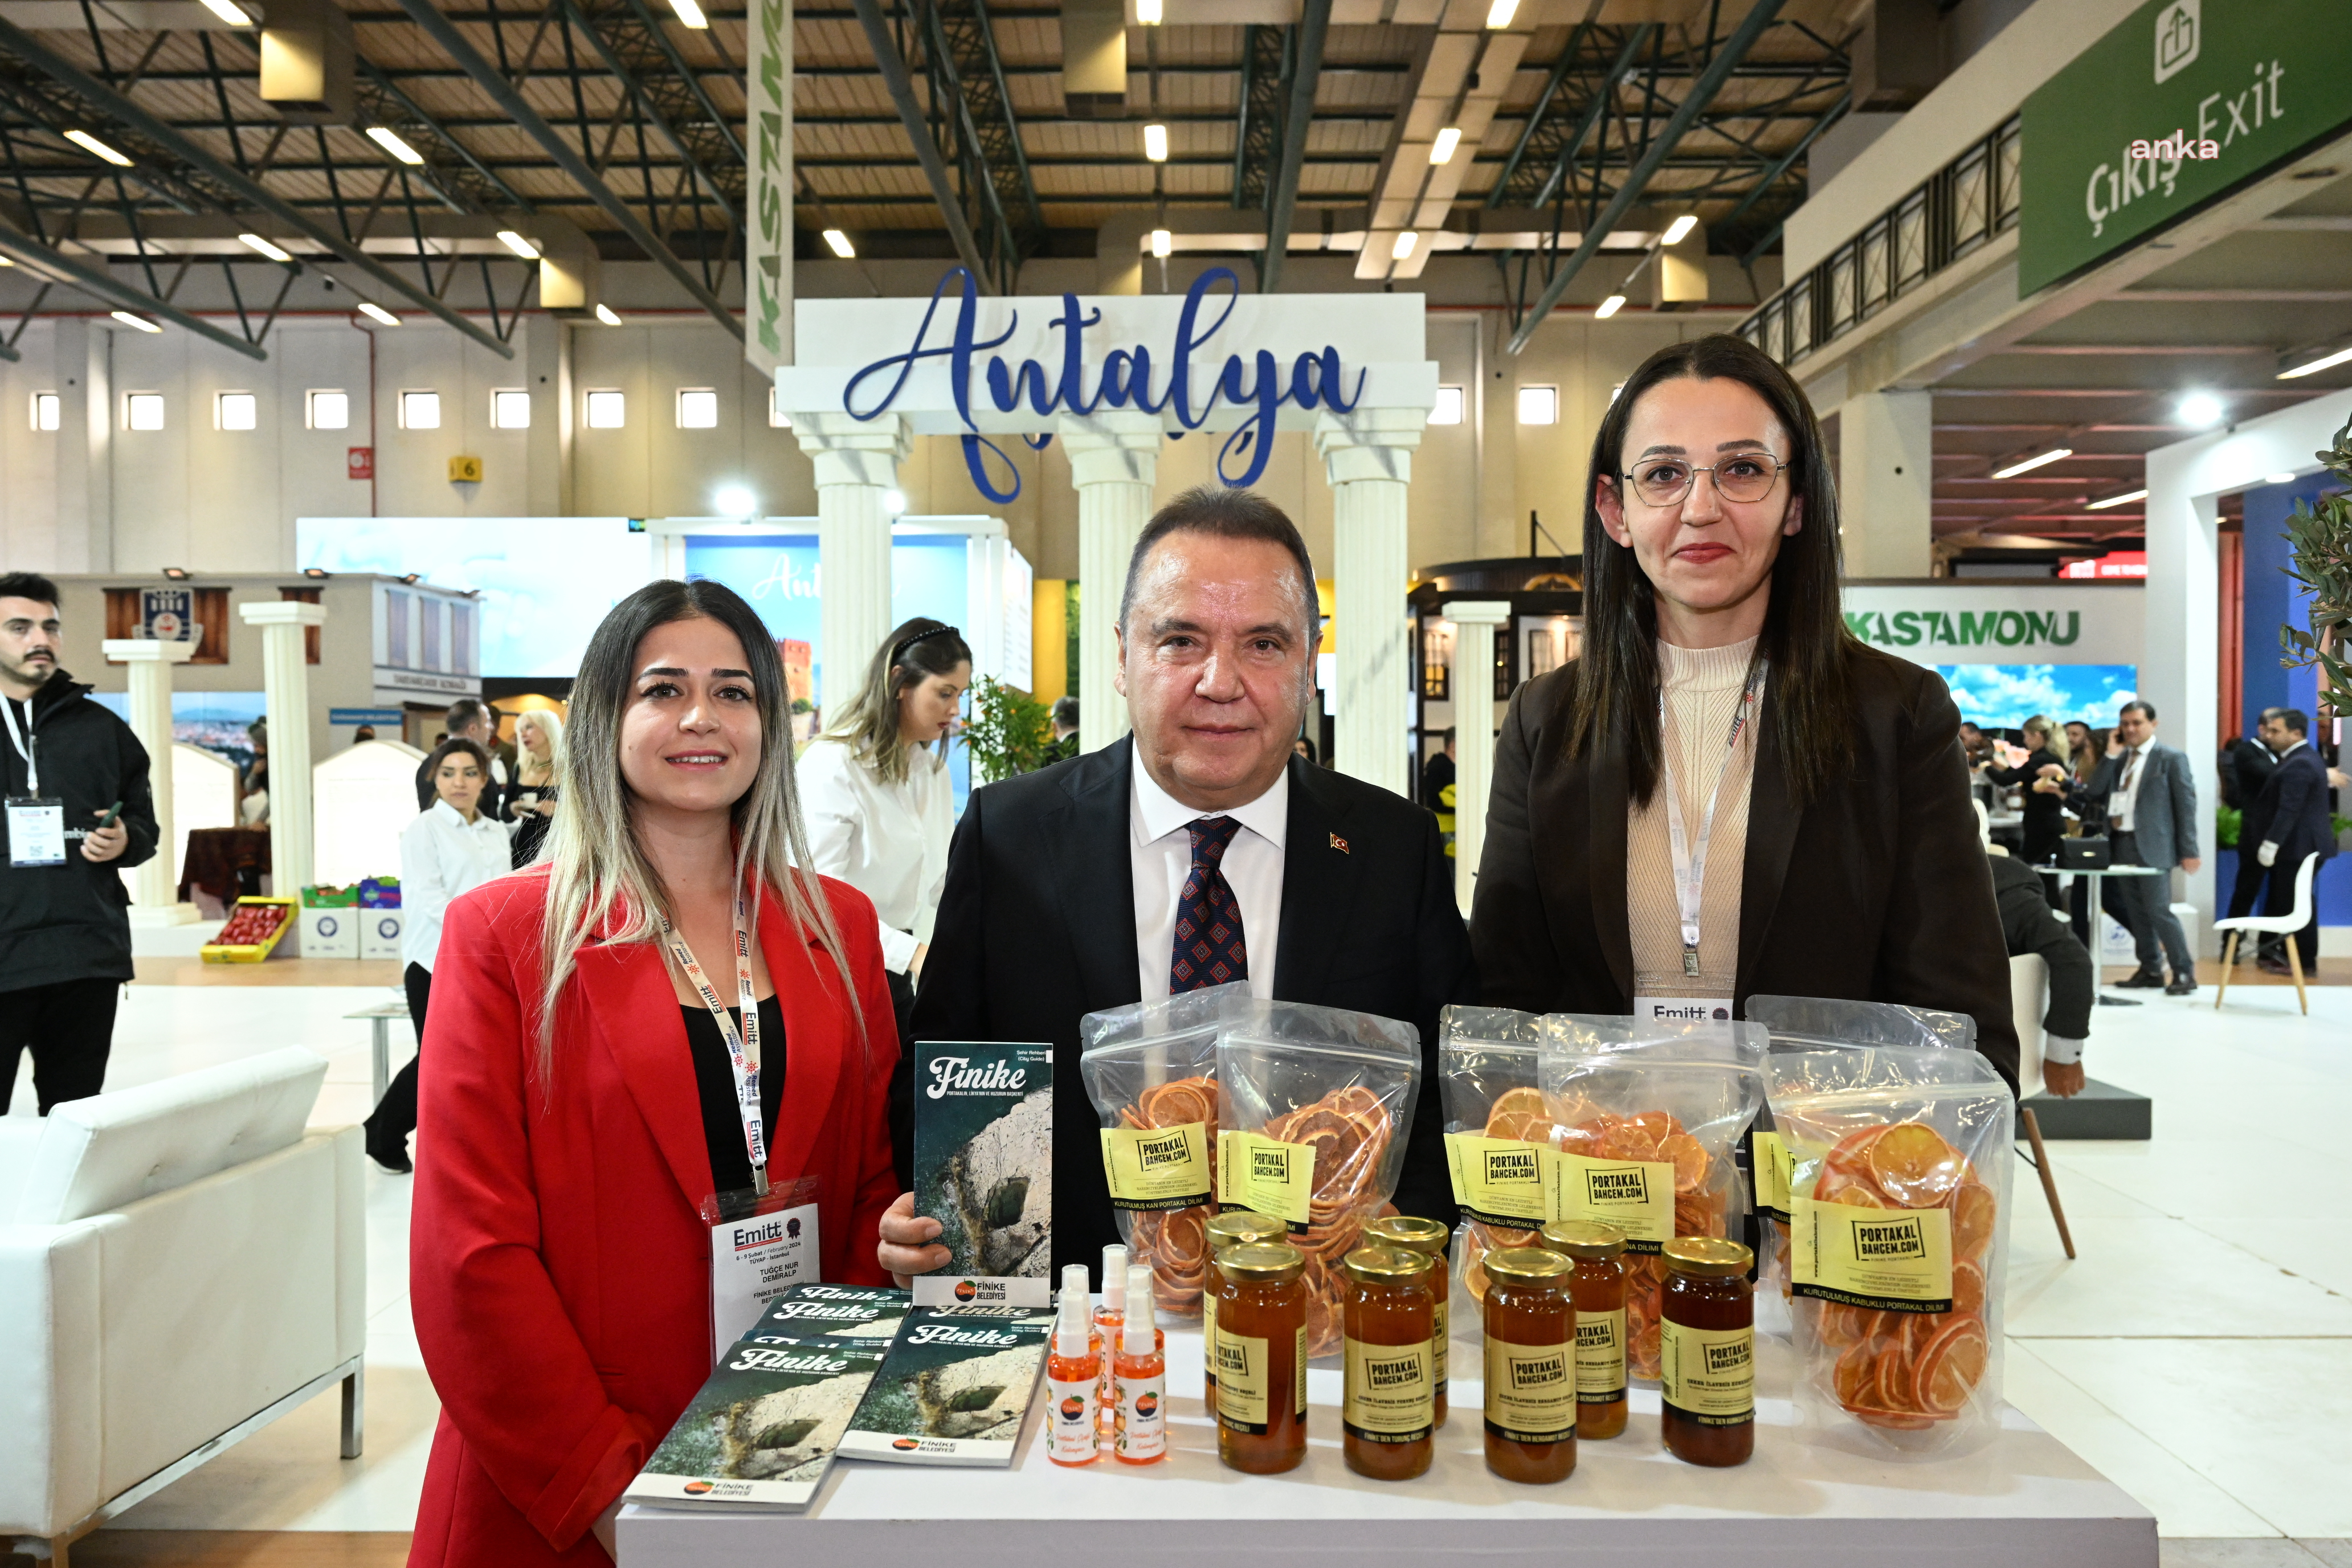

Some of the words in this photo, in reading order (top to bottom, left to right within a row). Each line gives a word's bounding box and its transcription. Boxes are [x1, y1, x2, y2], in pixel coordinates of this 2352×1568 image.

[2086, 131, 2184, 238] Çıkış
[2198, 58, 2285, 162] Exit
[843, 266, 1366, 504] Antalya
[1844, 610, 2080, 646] KASTAMONU
[738, 930, 749, 957] Emitt
[675, 949, 688, 964] Remed
[679, 942, 693, 962] Assistance
[700, 986, 723, 1014] Emitt
[746, 1012, 757, 1045] Emitt
[726, 1033, 736, 1053] Remed
[729, 1026, 741, 1052] Assistance
[926, 1056, 1026, 1099] Finike
[750, 1120, 762, 1158] Emitt
[1143, 1137, 1184, 1155] PORTAKAL
[1145, 1149, 1186, 1165] BAHCEM.COM
[1255, 1153, 1284, 1166] PORTAKAL
[1490, 1155, 1534, 1168] PORTAKAL
[1255, 1166, 1284, 1177] BAHCEM.COM
[1491, 1168, 1534, 1179] BAHCEM.COM
[1592, 1174, 1641, 1187] PORTAKAL
[1594, 1187, 1642, 1199] BAHCEM.COM
[1114, 1201, 1145, 1210] KURUTULMUŞ
[1159, 1199, 1186, 1208] PORTAKAL
[1483, 1216, 1506, 1225] KABUKLU
[1506, 1219, 1536, 1229] PORTAKAL
[734, 1221, 782, 1247] Emitt
[1860, 1224, 1917, 1242] PORTAKAL
[1861, 1240, 1918, 1254] BAHCEM.COM
[770, 1251, 789, 1260] İstanbul
[760, 1265, 783, 1276] TUĞÇE
[763, 1270, 797, 1283] DEMİRALP
[754, 1290, 771, 1298] FİNİKE
[977, 1281, 1005, 1291] FİNİKE
[977, 1291, 1005, 1300] BELEDİYESİ
[1803, 1288, 1850, 1302] KURUTULMUŞ
[1851, 1298, 1885, 1308] KABUKLU
[1886, 1301, 1922, 1311] PORTAKAL
[773, 1301, 879, 1319] Finike
[908, 1325, 1018, 1344] Finike
[1577, 1325, 1609, 1338] RTAKAL
[1577, 1335, 1611, 1346] HCEM.COM
[1710, 1341, 1749, 1359] PORTAKAL
[730, 1348, 848, 1371] Finike
[1371, 1359, 1416, 1375] PORTAKAL
[1516, 1358, 1562, 1374] PORTAKAL
[1373, 1370, 1418, 1385] BAHCEM.COM
[1517, 1370, 1562, 1384] BAHCEM.COM
